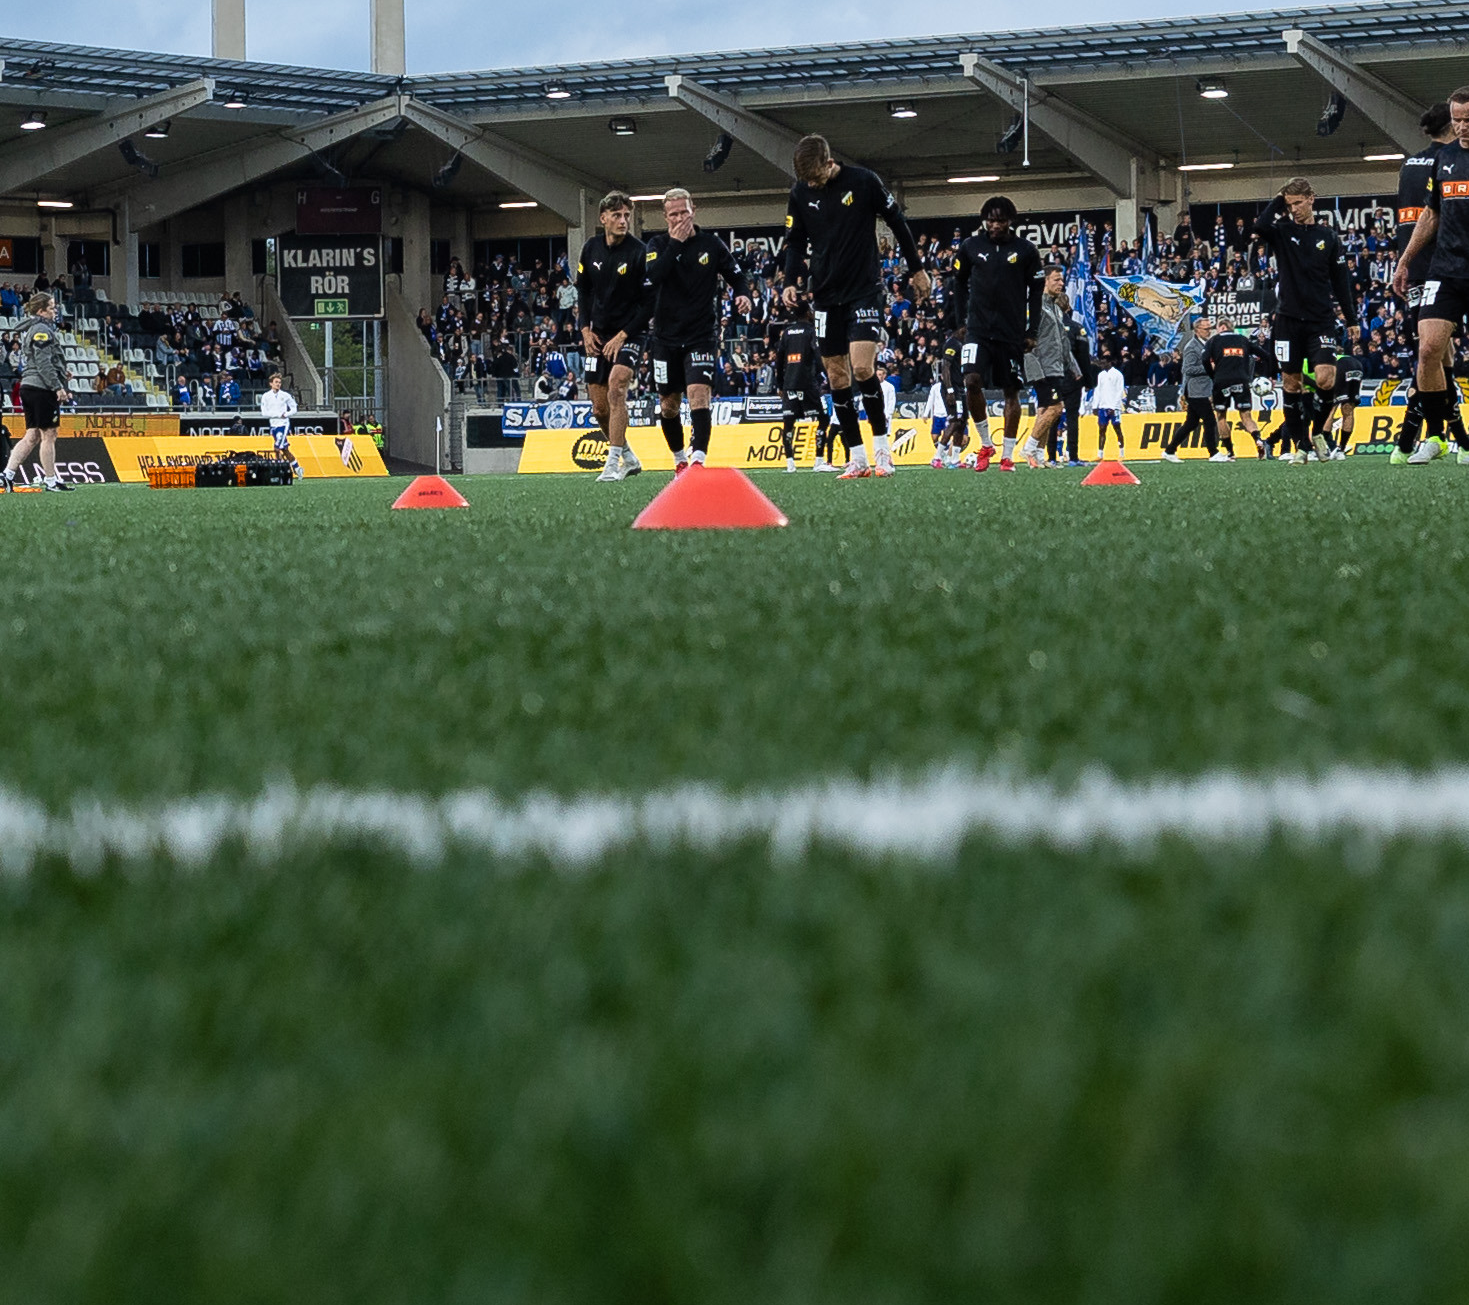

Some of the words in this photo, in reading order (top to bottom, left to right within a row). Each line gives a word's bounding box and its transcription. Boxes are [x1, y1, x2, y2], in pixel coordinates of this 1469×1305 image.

[310, 271, 350, 295] RÖR
[1210, 292, 1237, 303] THE
[1207, 302, 1261, 314] BROWN
[85, 415, 134, 429] NORDIC
[504, 403, 543, 427] SÄ
